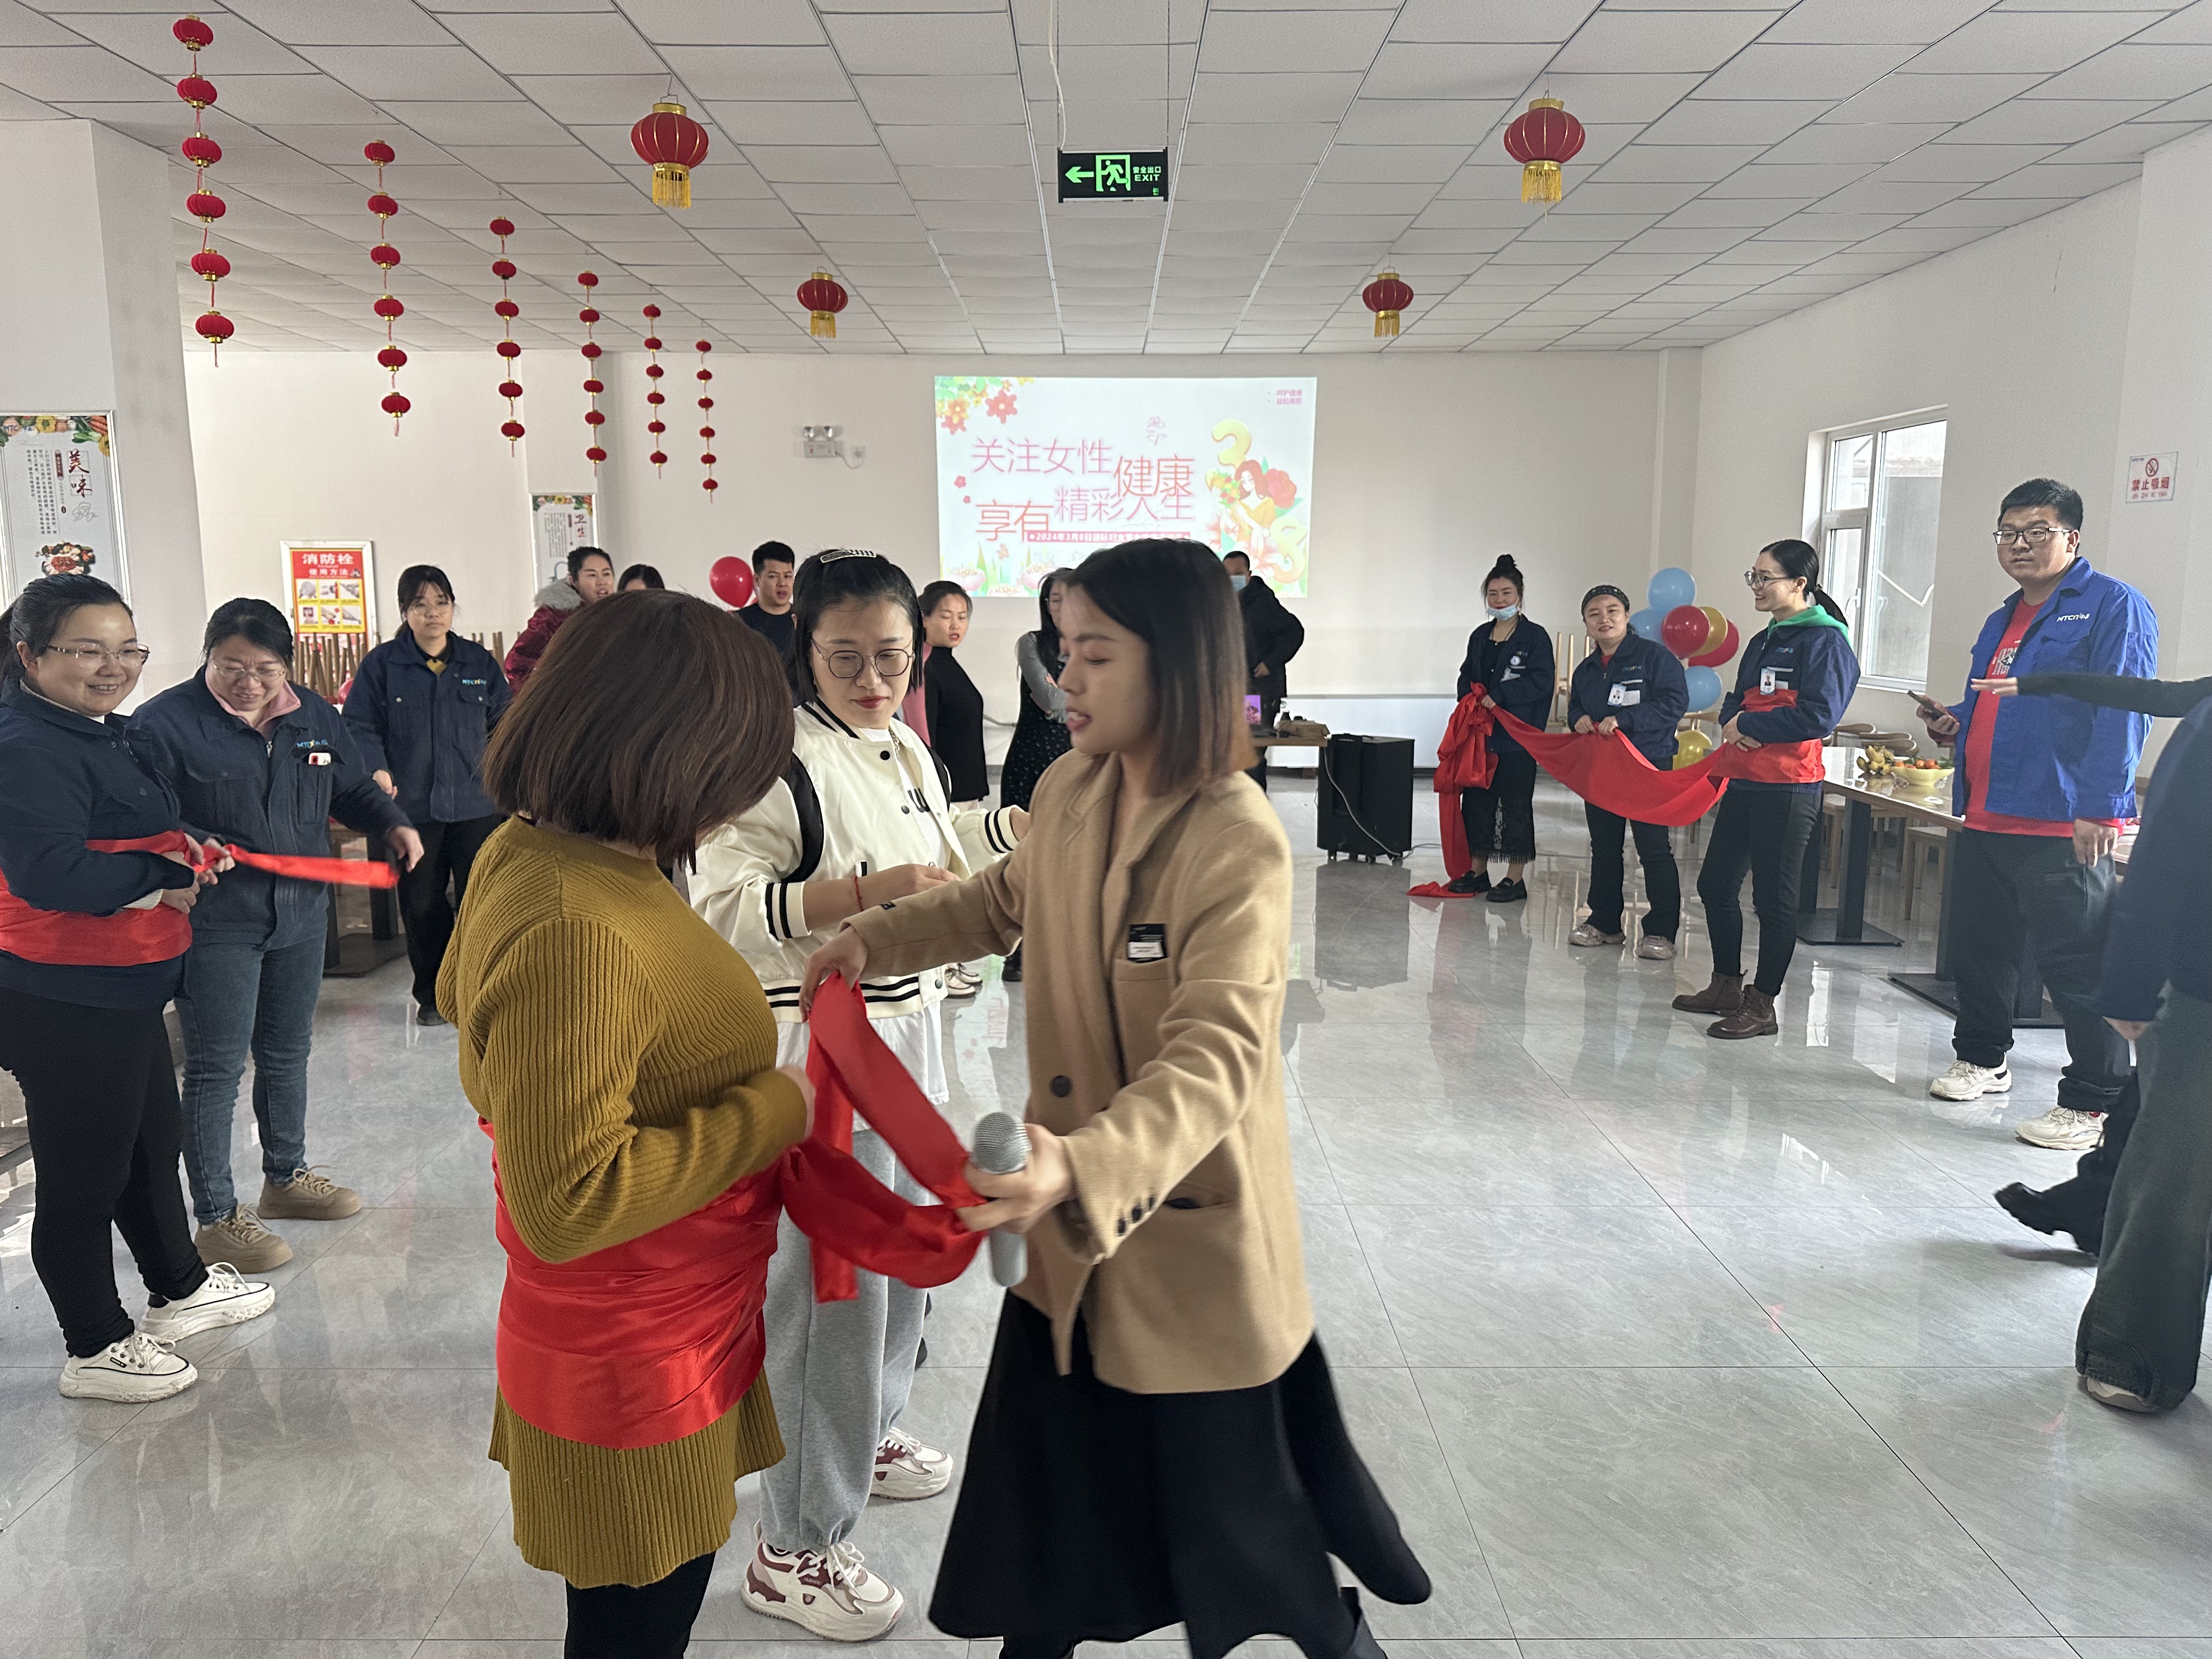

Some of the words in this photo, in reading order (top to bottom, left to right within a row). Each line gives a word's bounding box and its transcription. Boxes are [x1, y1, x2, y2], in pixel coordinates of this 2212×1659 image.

[972, 438, 1112, 475] 关注女性
[1114, 455, 1194, 497] 健康
[2131, 477, 2170, 492] 禁止吸烟
[975, 500, 1054, 542] 享有
[1054, 487, 1194, 521] 精彩人生
[302, 553, 353, 565] 消防栓
